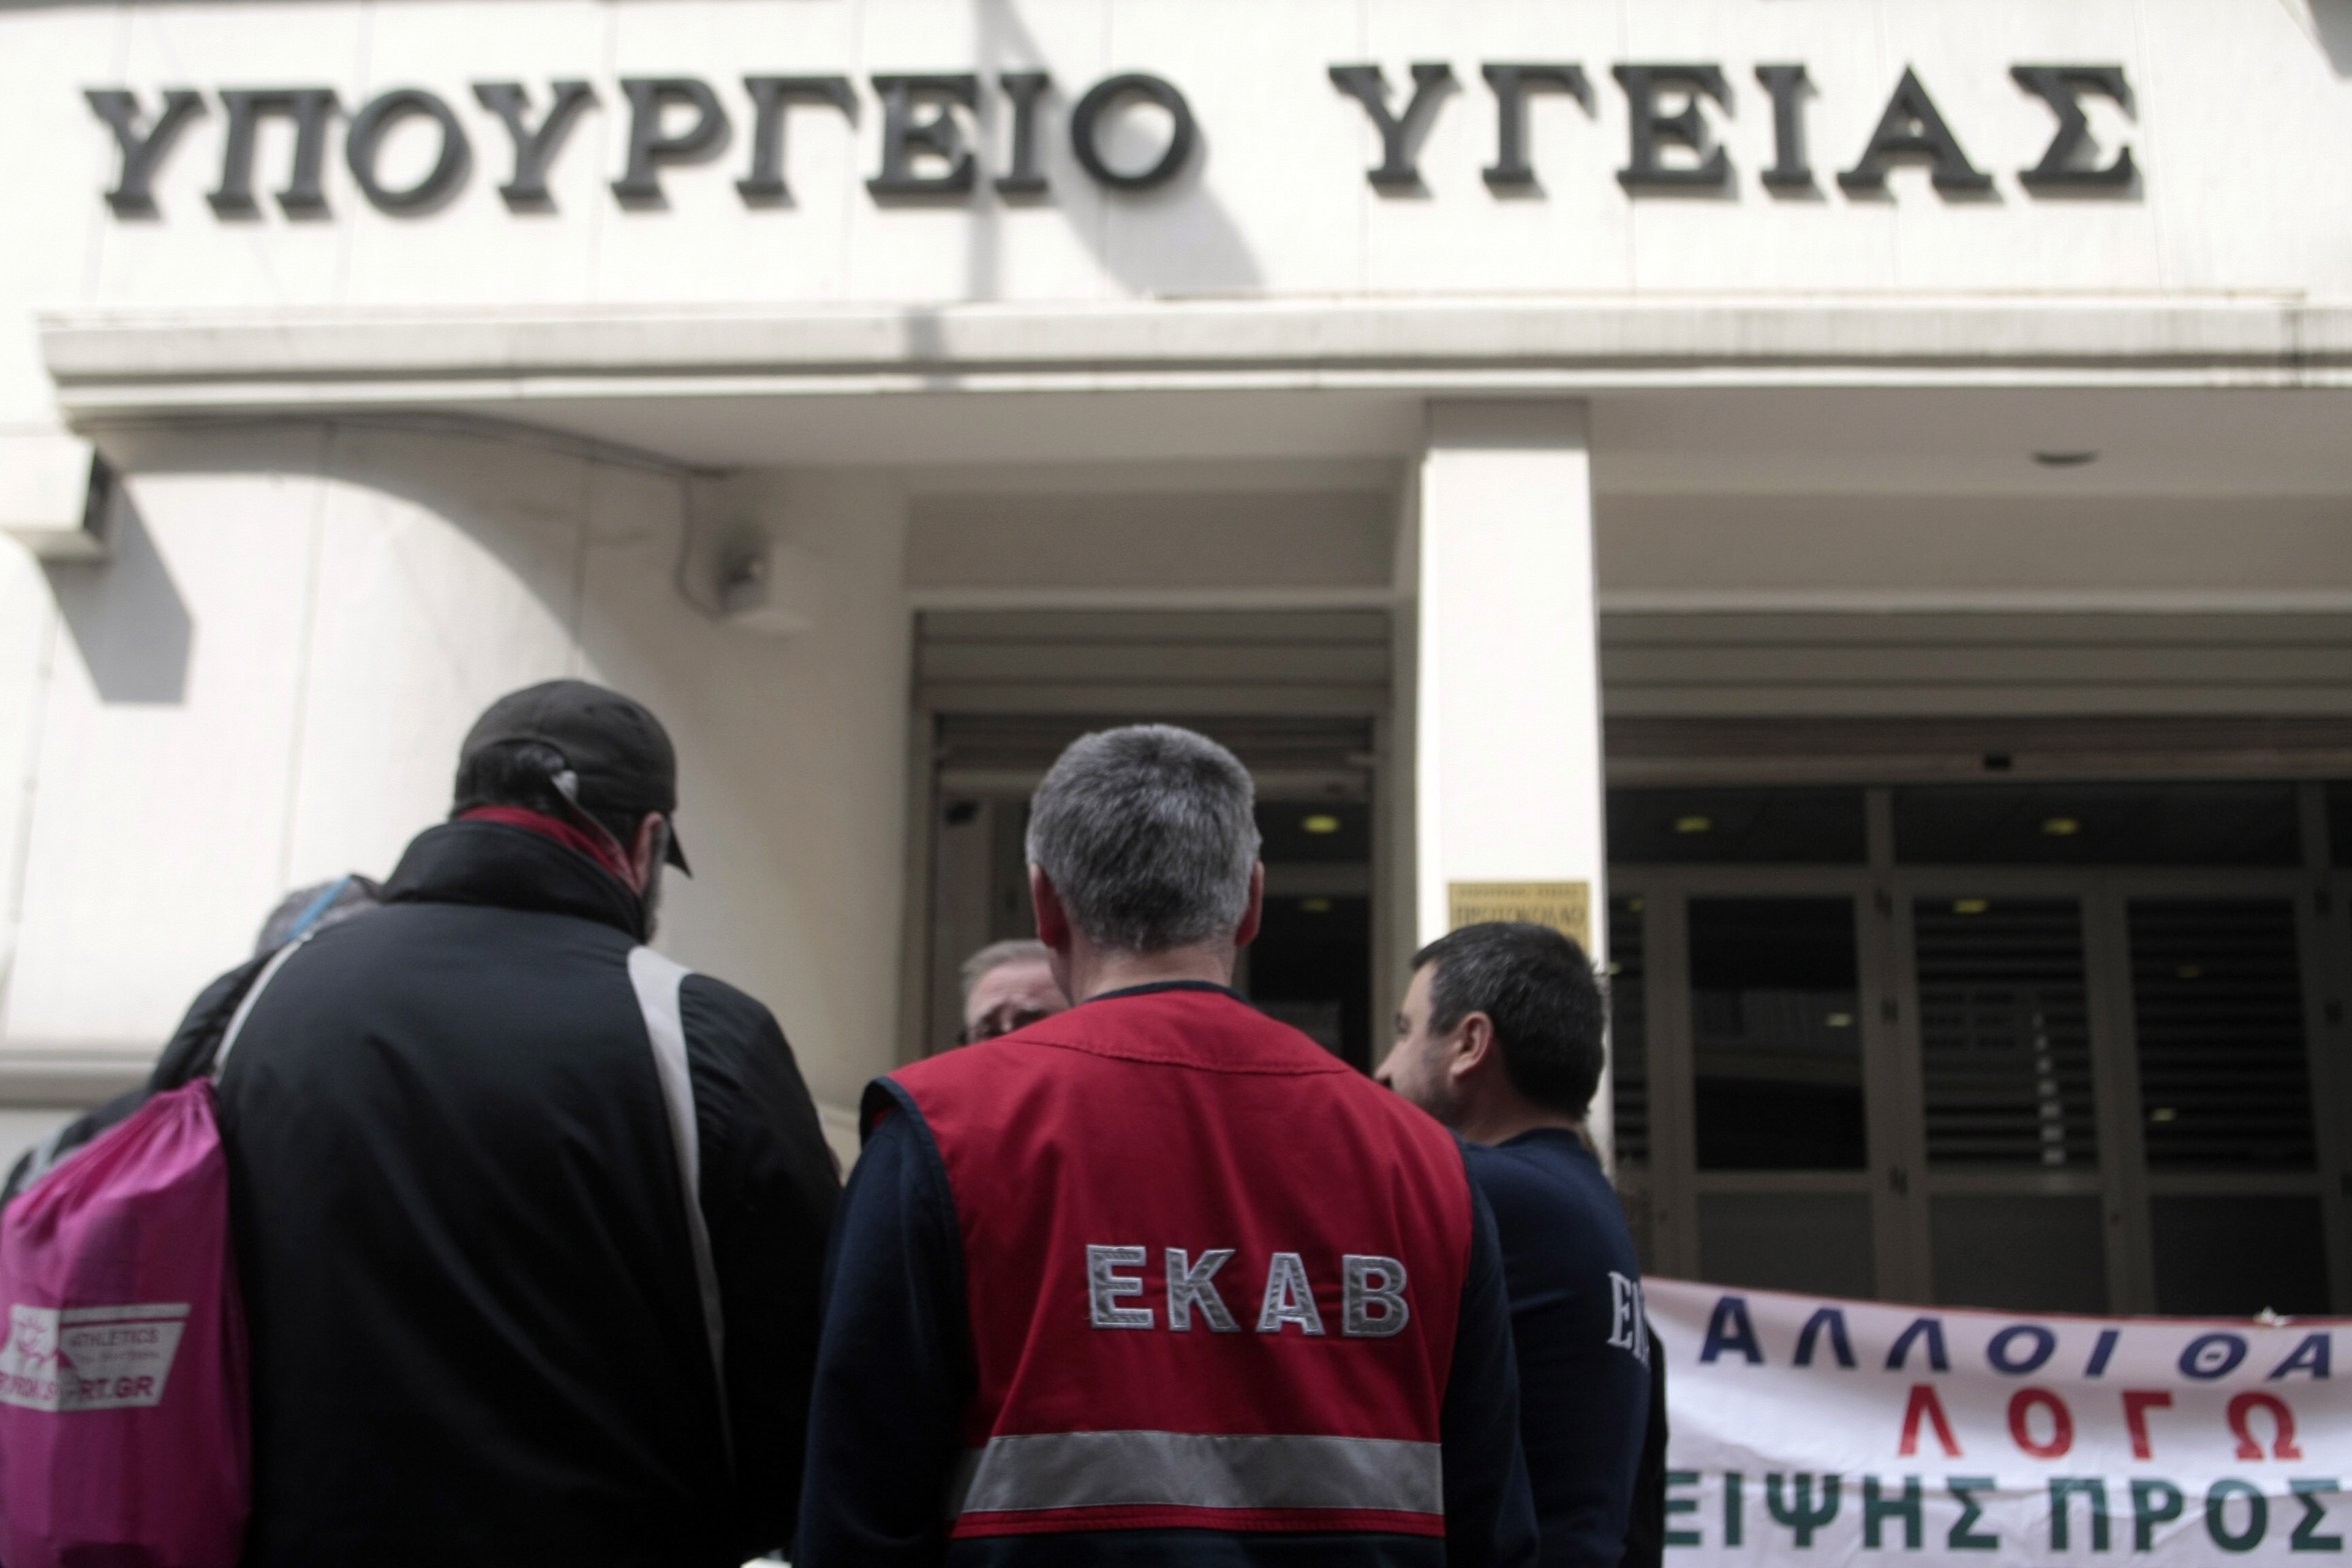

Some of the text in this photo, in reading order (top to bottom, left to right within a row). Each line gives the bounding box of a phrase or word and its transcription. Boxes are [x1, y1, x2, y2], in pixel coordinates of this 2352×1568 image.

[83, 63, 2138, 216] ΥΠΟΥΡΓΕΙΟ ΥΓΕΙΑΣ
[1085, 1244, 1410, 1338] ΕΚΑΒ
[1698, 1296, 2334, 1382] ΑΛΛΟΙ ΘΑ
[1898, 1384, 2304, 1461] ΛΟΓΩ
[2048, 1477, 2345, 1553] ΠΡΟΣ
